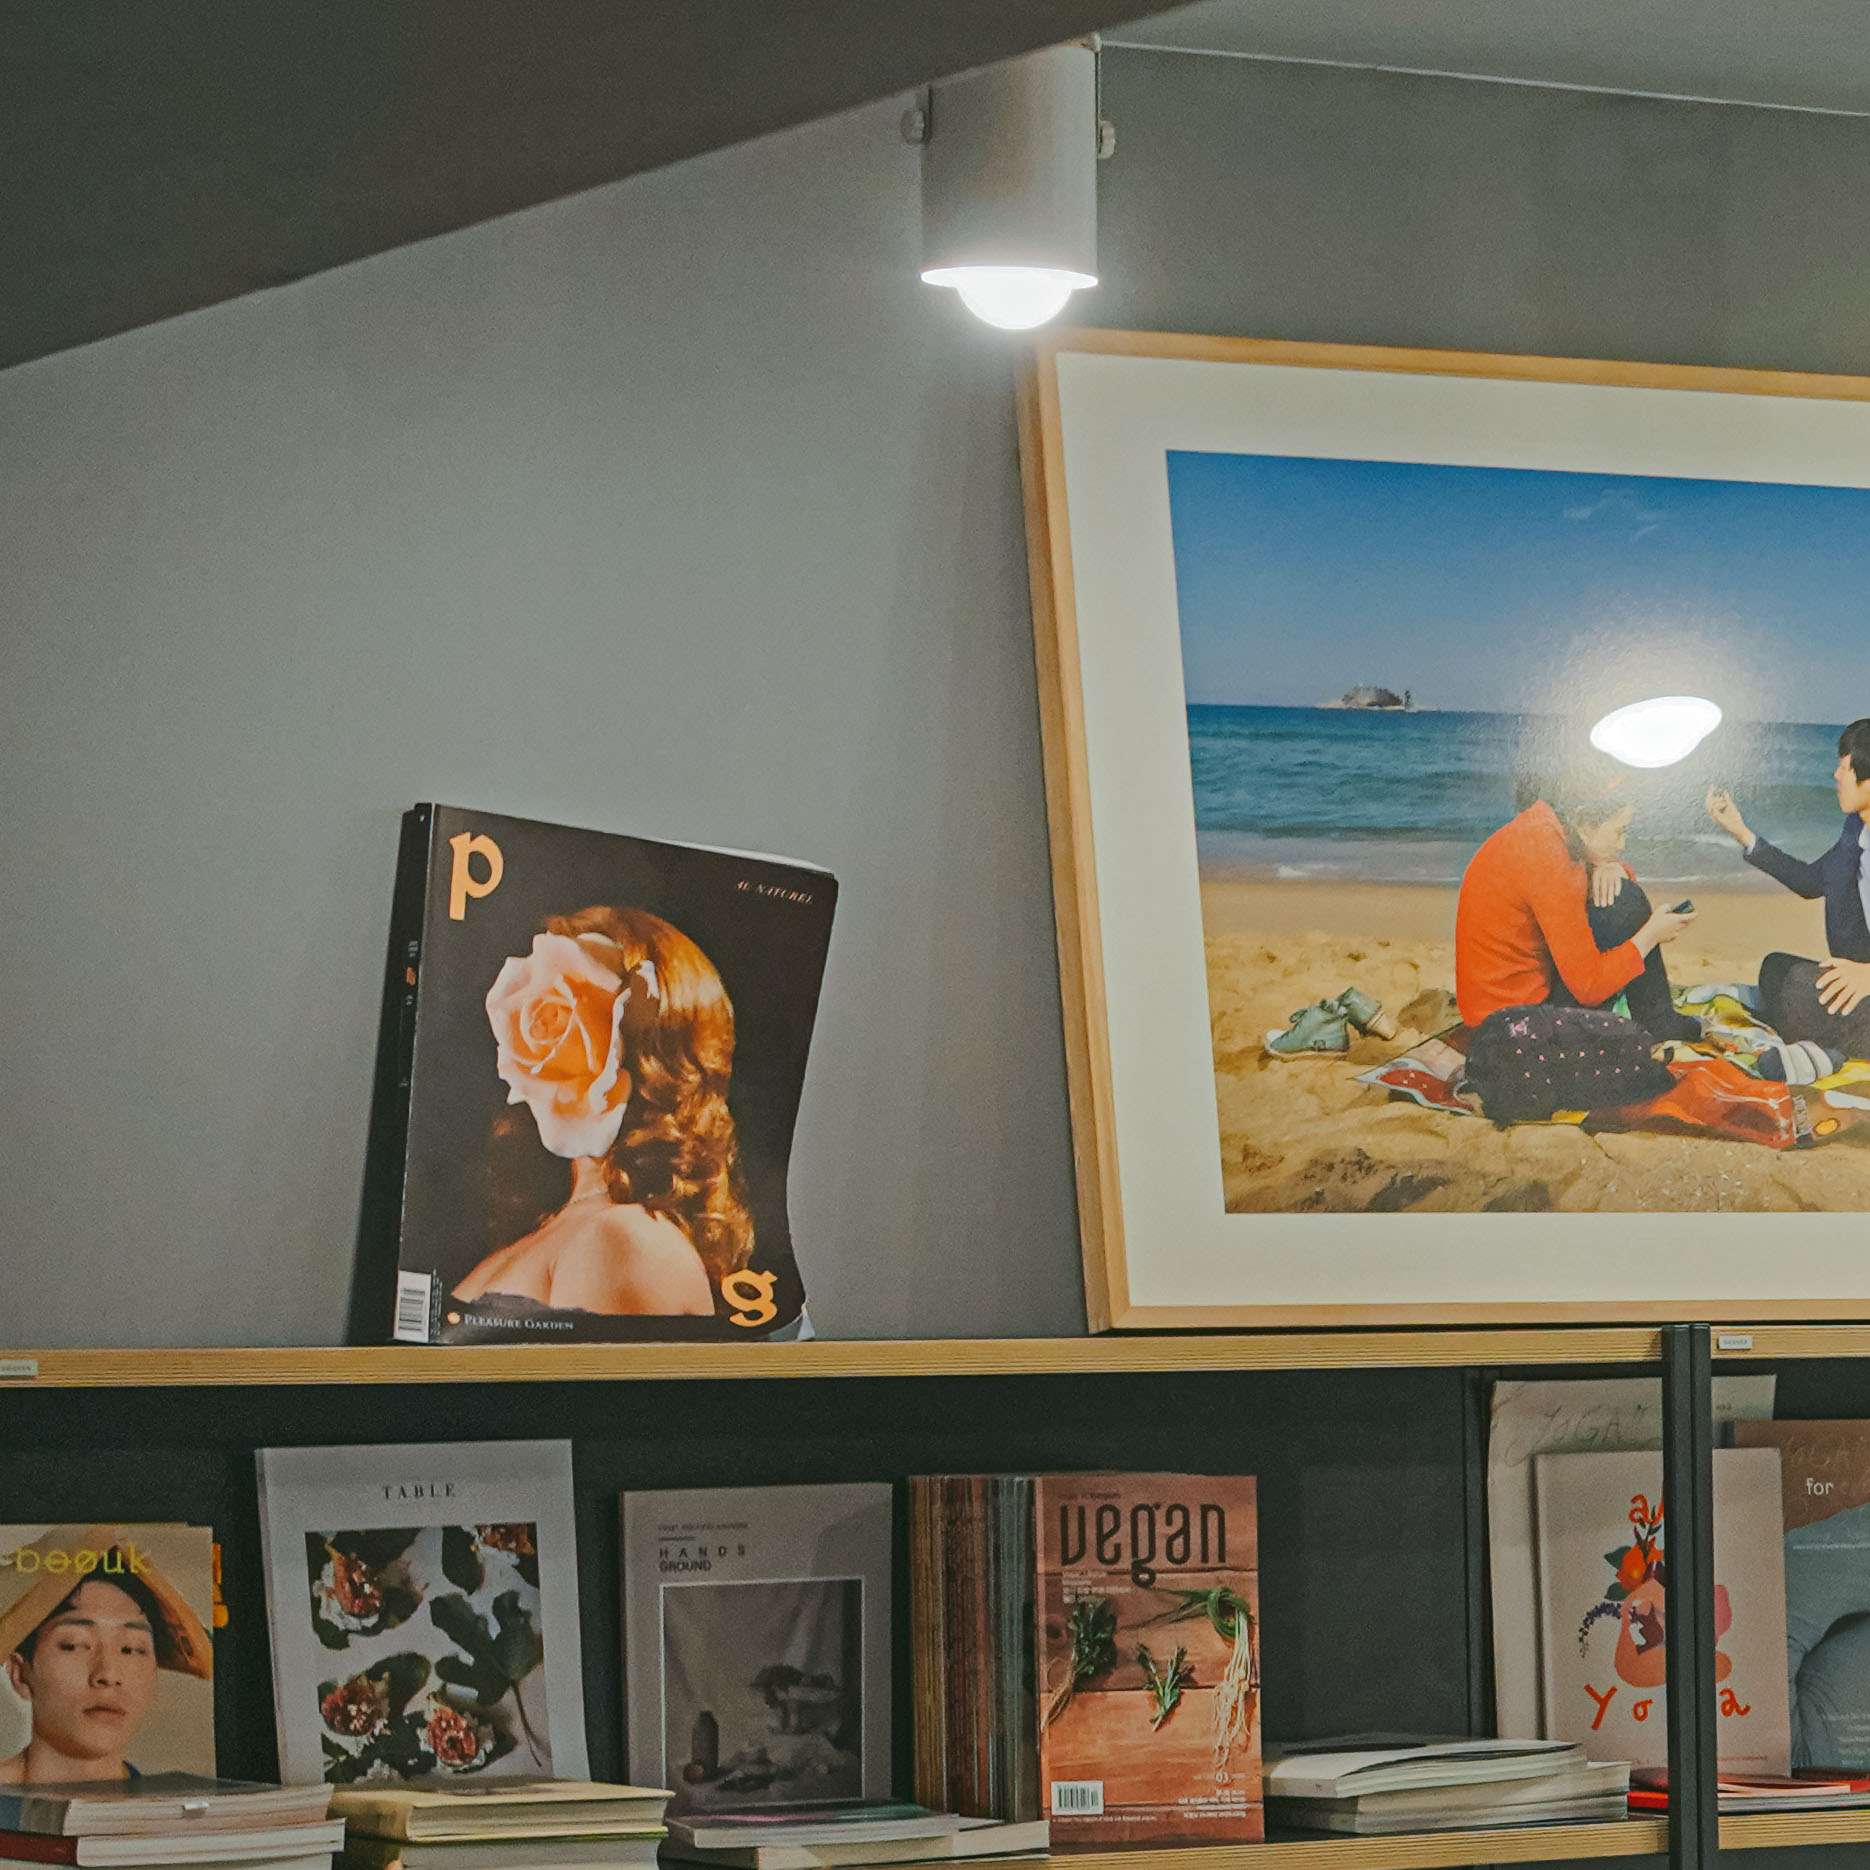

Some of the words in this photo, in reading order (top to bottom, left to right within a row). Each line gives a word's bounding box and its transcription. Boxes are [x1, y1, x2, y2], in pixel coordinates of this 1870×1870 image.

[449, 831, 504, 920] p
[464, 1313, 522, 1329] PLEASURE
[721, 1268, 777, 1328] g
[381, 1481, 458, 1501] TABLE
[1805, 1477, 1834, 1497] for
[1060, 1502, 1226, 1587] vegan
[1584, 1684, 1752, 1731] Yoa
